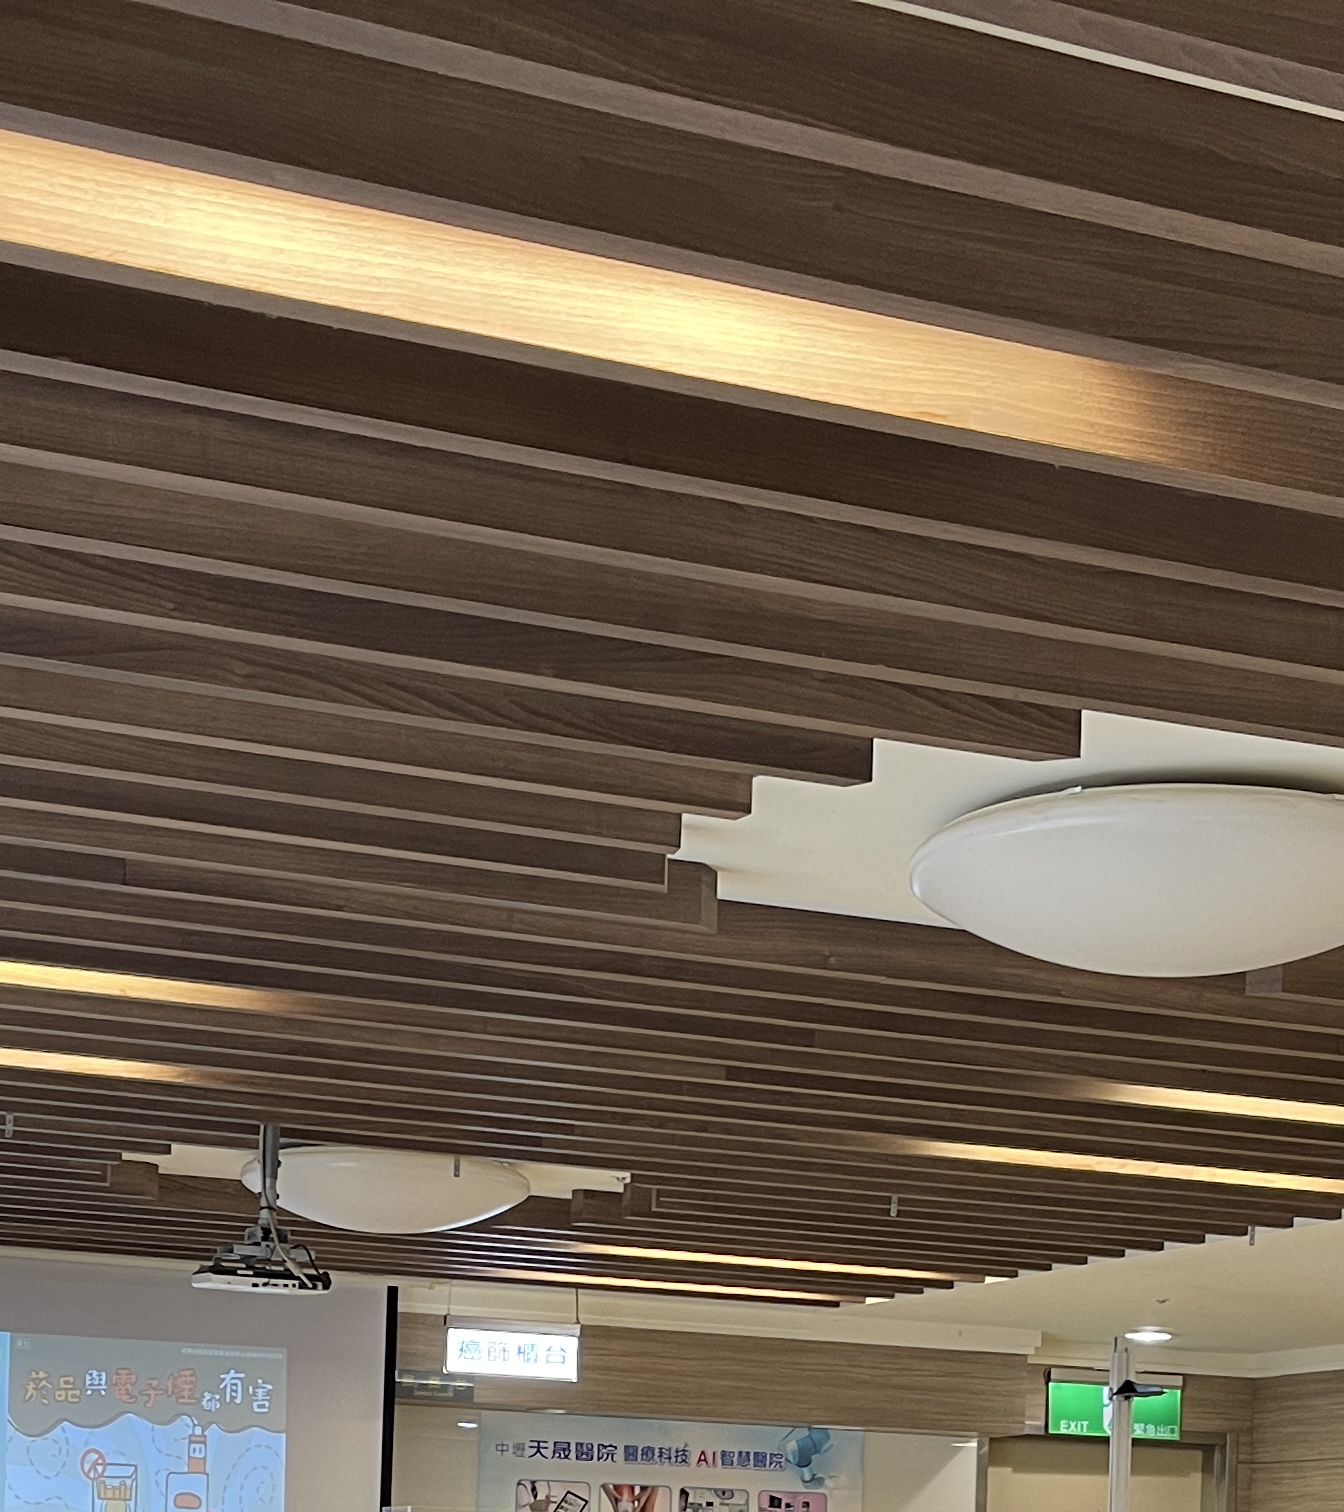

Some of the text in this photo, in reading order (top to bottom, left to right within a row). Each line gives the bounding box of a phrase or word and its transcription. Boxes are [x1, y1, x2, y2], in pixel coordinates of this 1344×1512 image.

[457, 1339, 568, 1365] 癌篩櫃台
[1059, 1419, 1090, 1434] EXIT
[1133, 1422, 1178, 1437] 緊急出口
